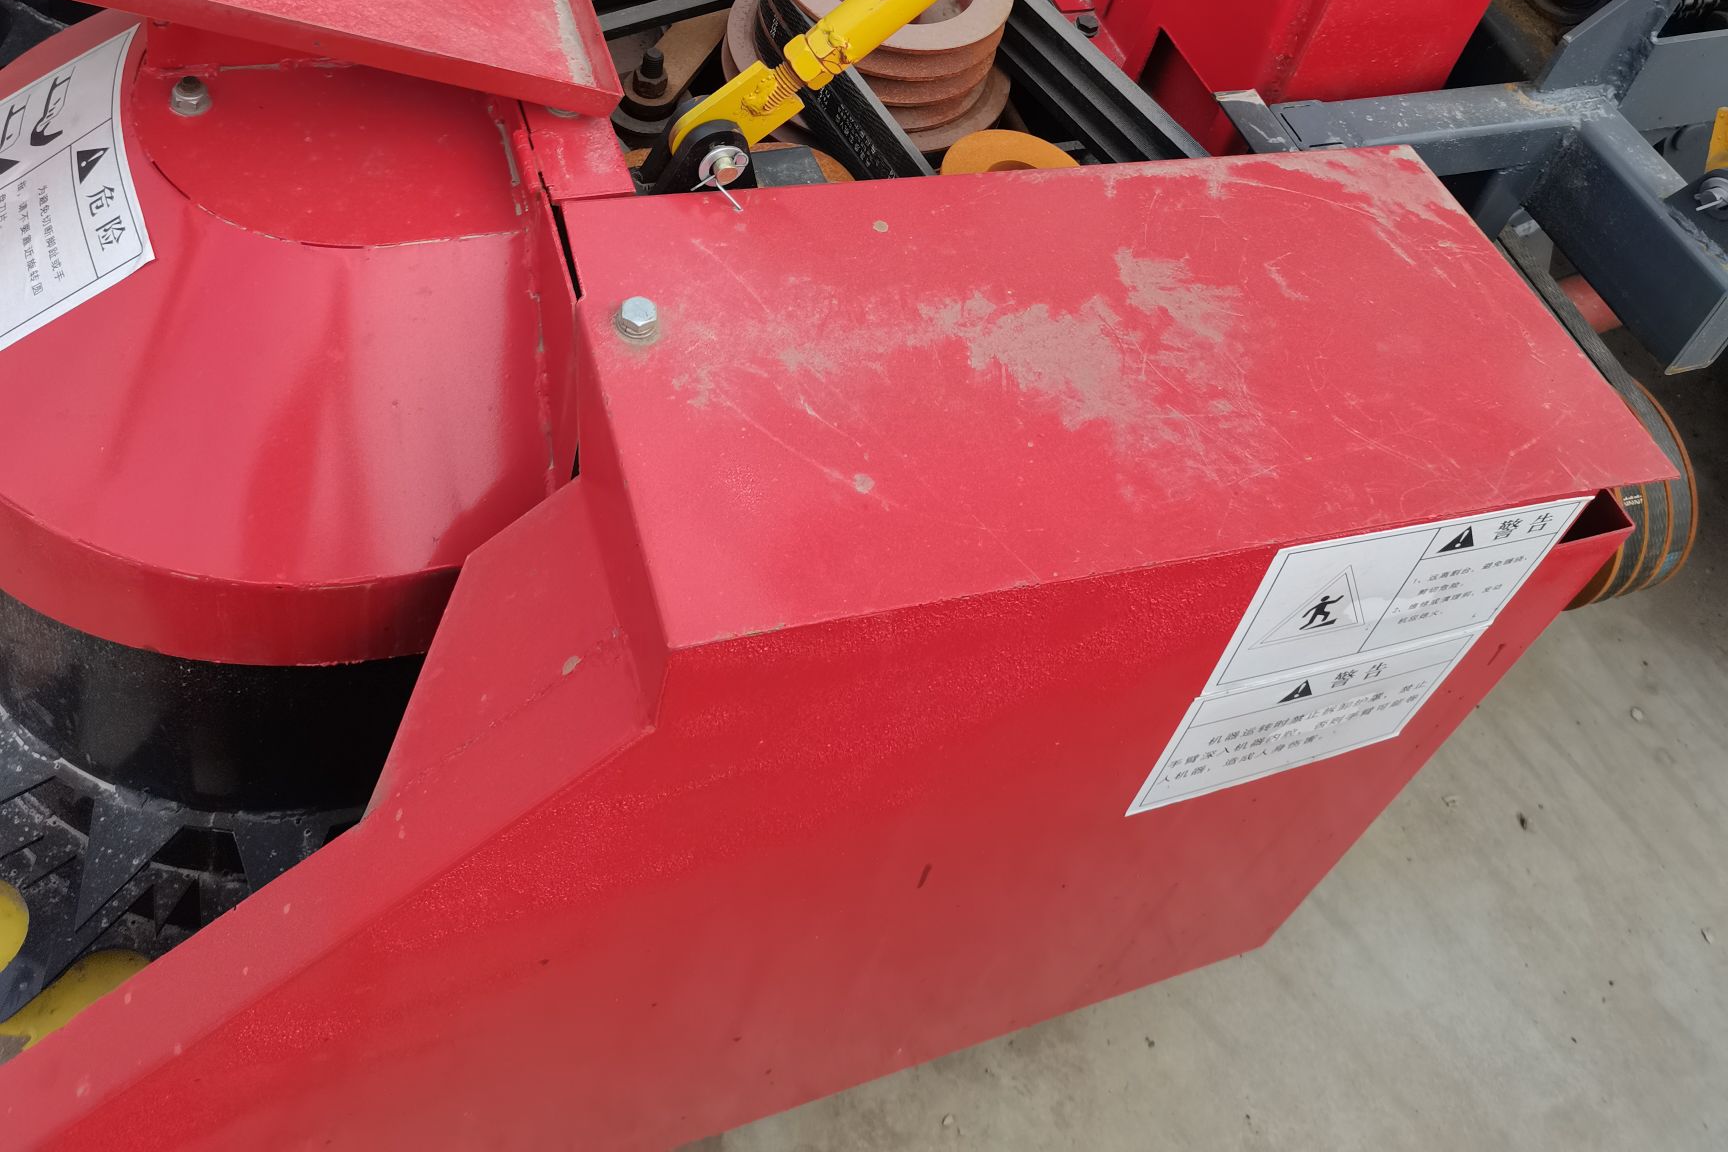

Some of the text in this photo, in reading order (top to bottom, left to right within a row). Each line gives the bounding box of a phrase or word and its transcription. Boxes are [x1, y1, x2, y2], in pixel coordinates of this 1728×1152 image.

[37, 185, 65, 281] 为避免切断脚趾或手
[86, 185, 126, 251] 危险
[1493, 512, 1554, 541] 警告
[1330, 662, 1387, 689] 警告
